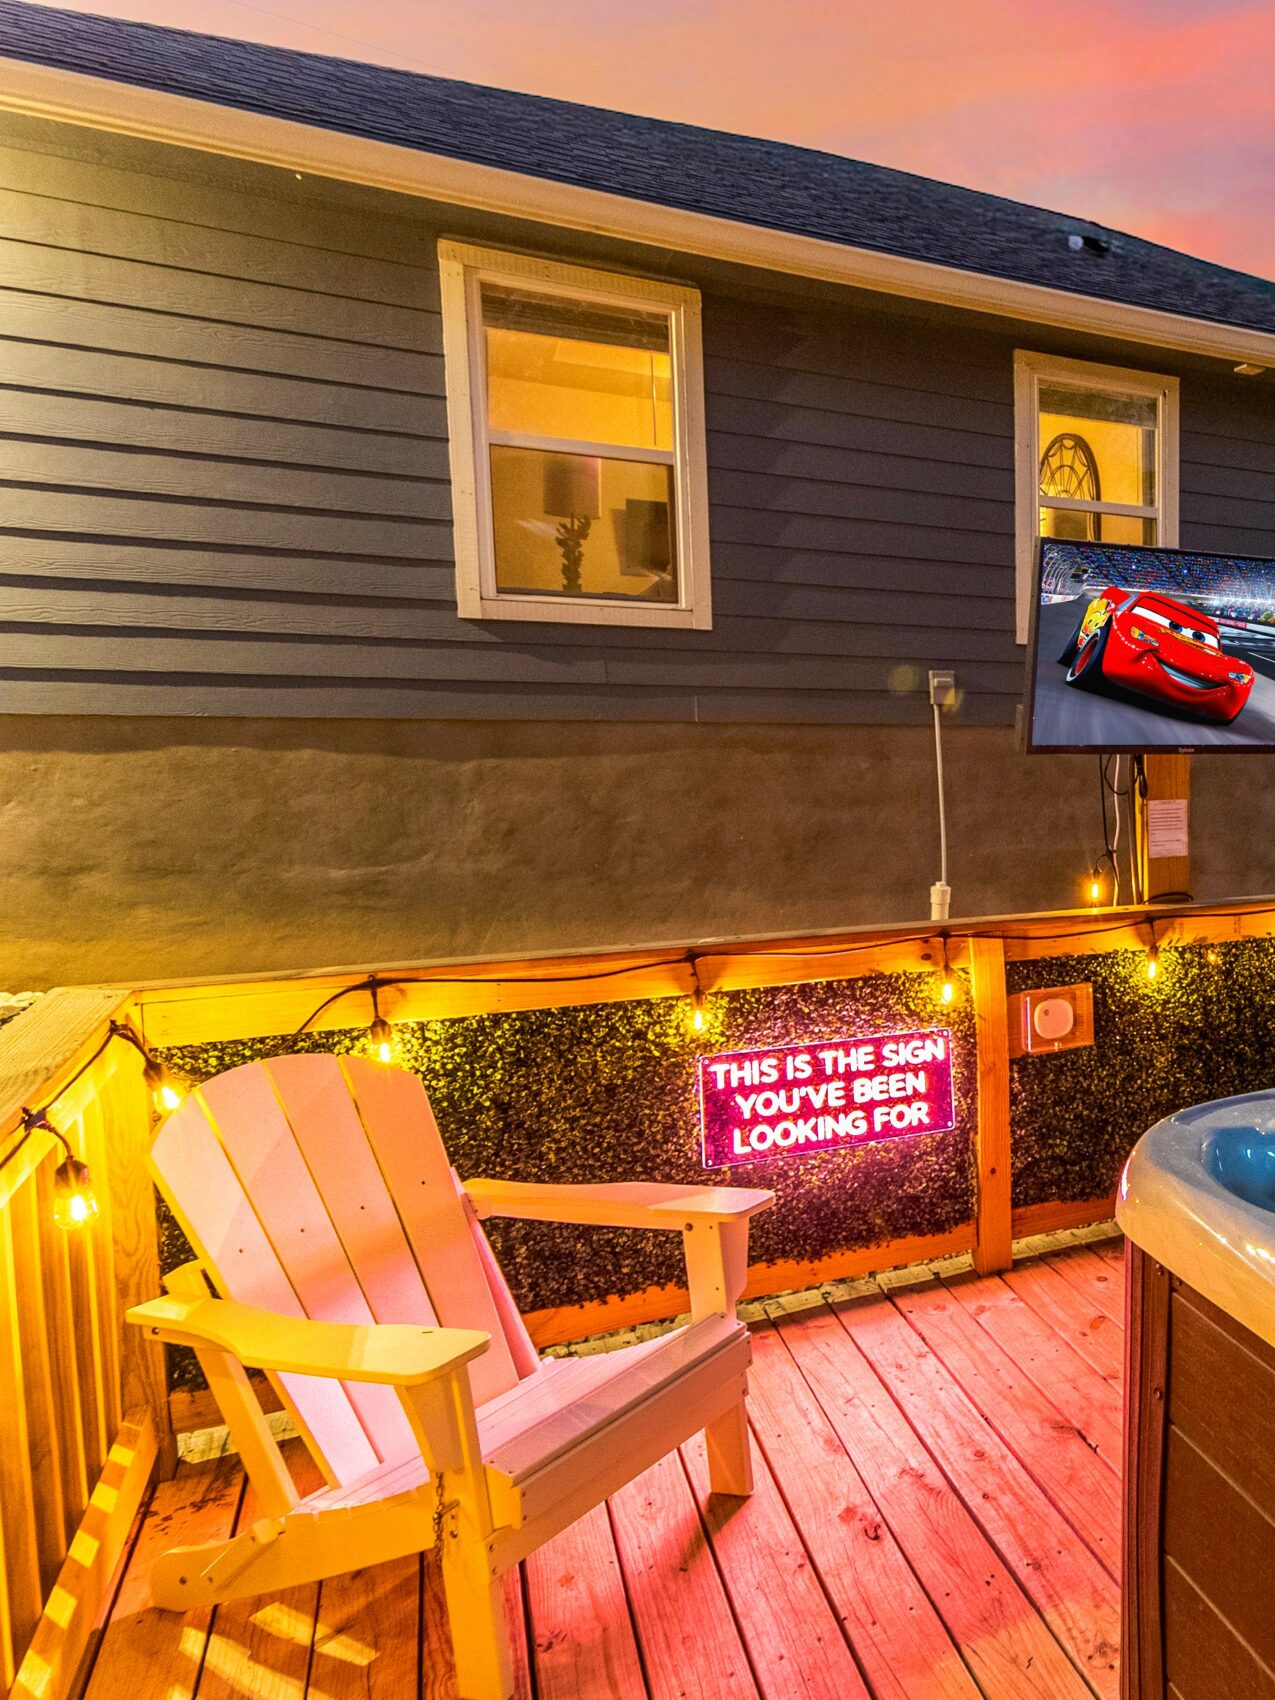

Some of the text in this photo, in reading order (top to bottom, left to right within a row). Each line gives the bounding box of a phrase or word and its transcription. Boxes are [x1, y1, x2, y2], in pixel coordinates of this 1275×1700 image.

[709, 1038, 944, 1089] THIS IS THE SIGN
[735, 1071, 926, 1119] YOU'VE BEEN
[733, 1102, 929, 1154] LOOKING FOR
